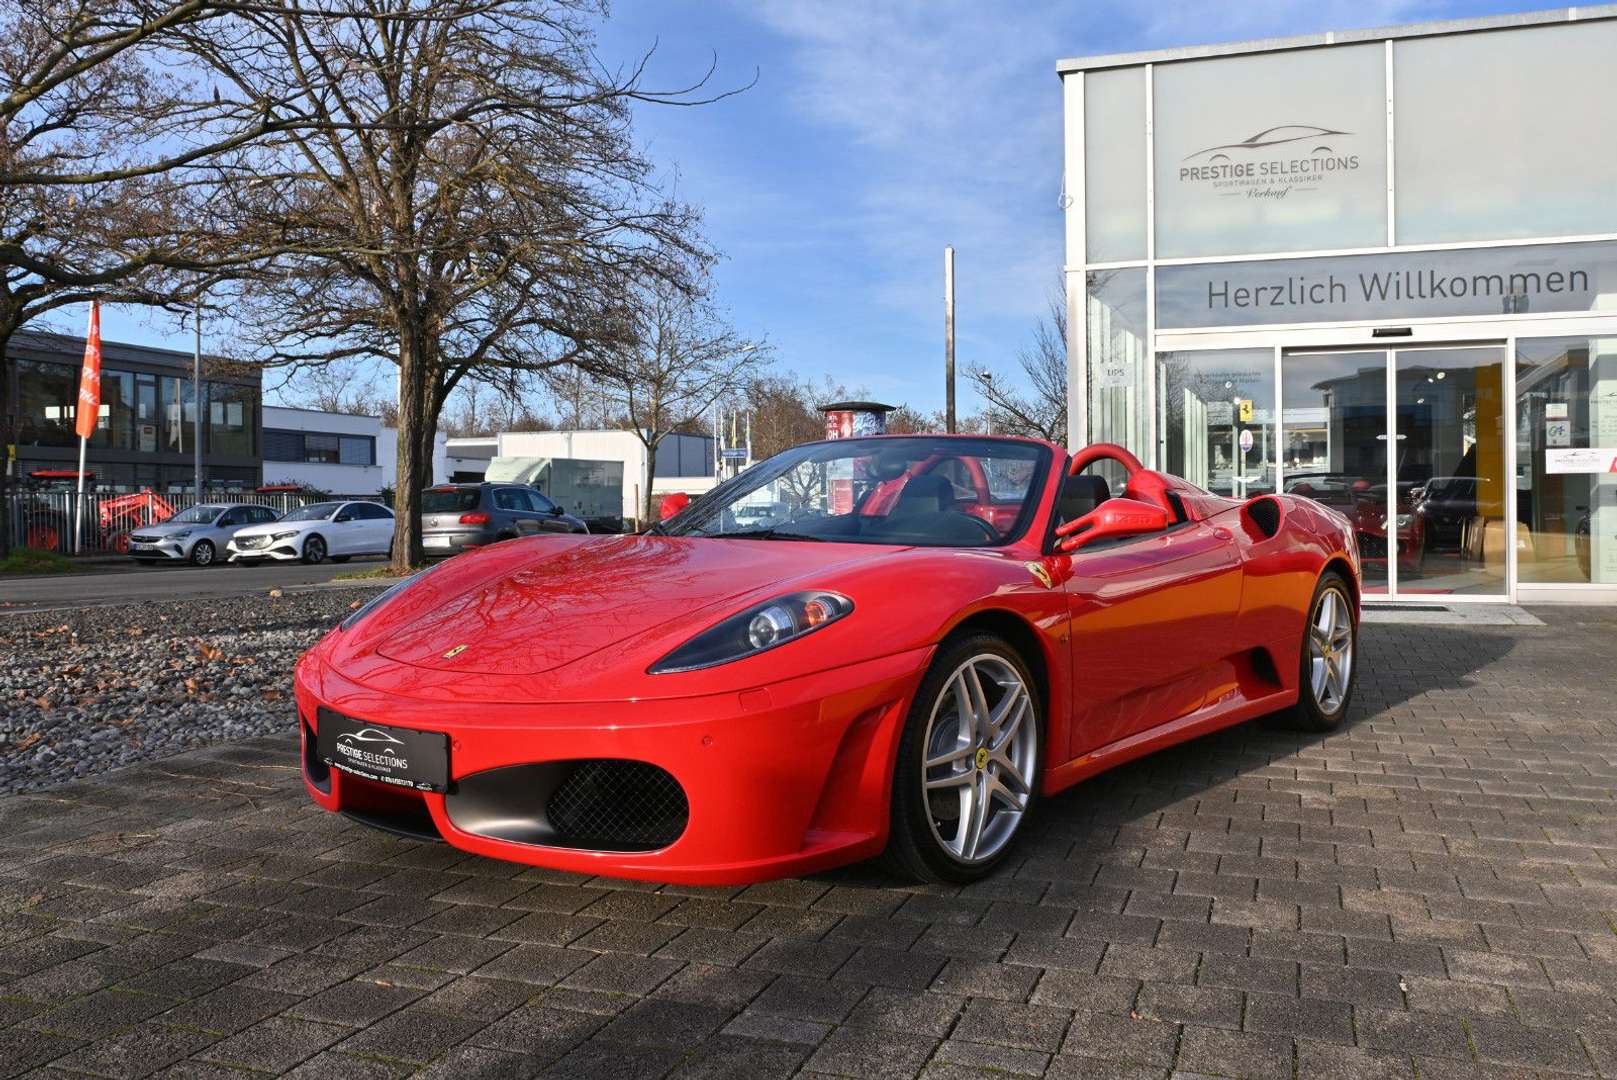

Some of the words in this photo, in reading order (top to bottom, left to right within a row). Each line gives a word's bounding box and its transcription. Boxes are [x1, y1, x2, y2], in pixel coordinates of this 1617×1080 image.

[1179, 162, 1256, 181] PRESTIGE
[1259, 155, 1360, 176] SELECTIONS
[1207, 275, 1347, 309] Herzlich
[1358, 269, 1589, 302] Willkommen
[336, 742, 363, 760] PRESTIGE
[363, 751, 408, 769] SELECTIONS
